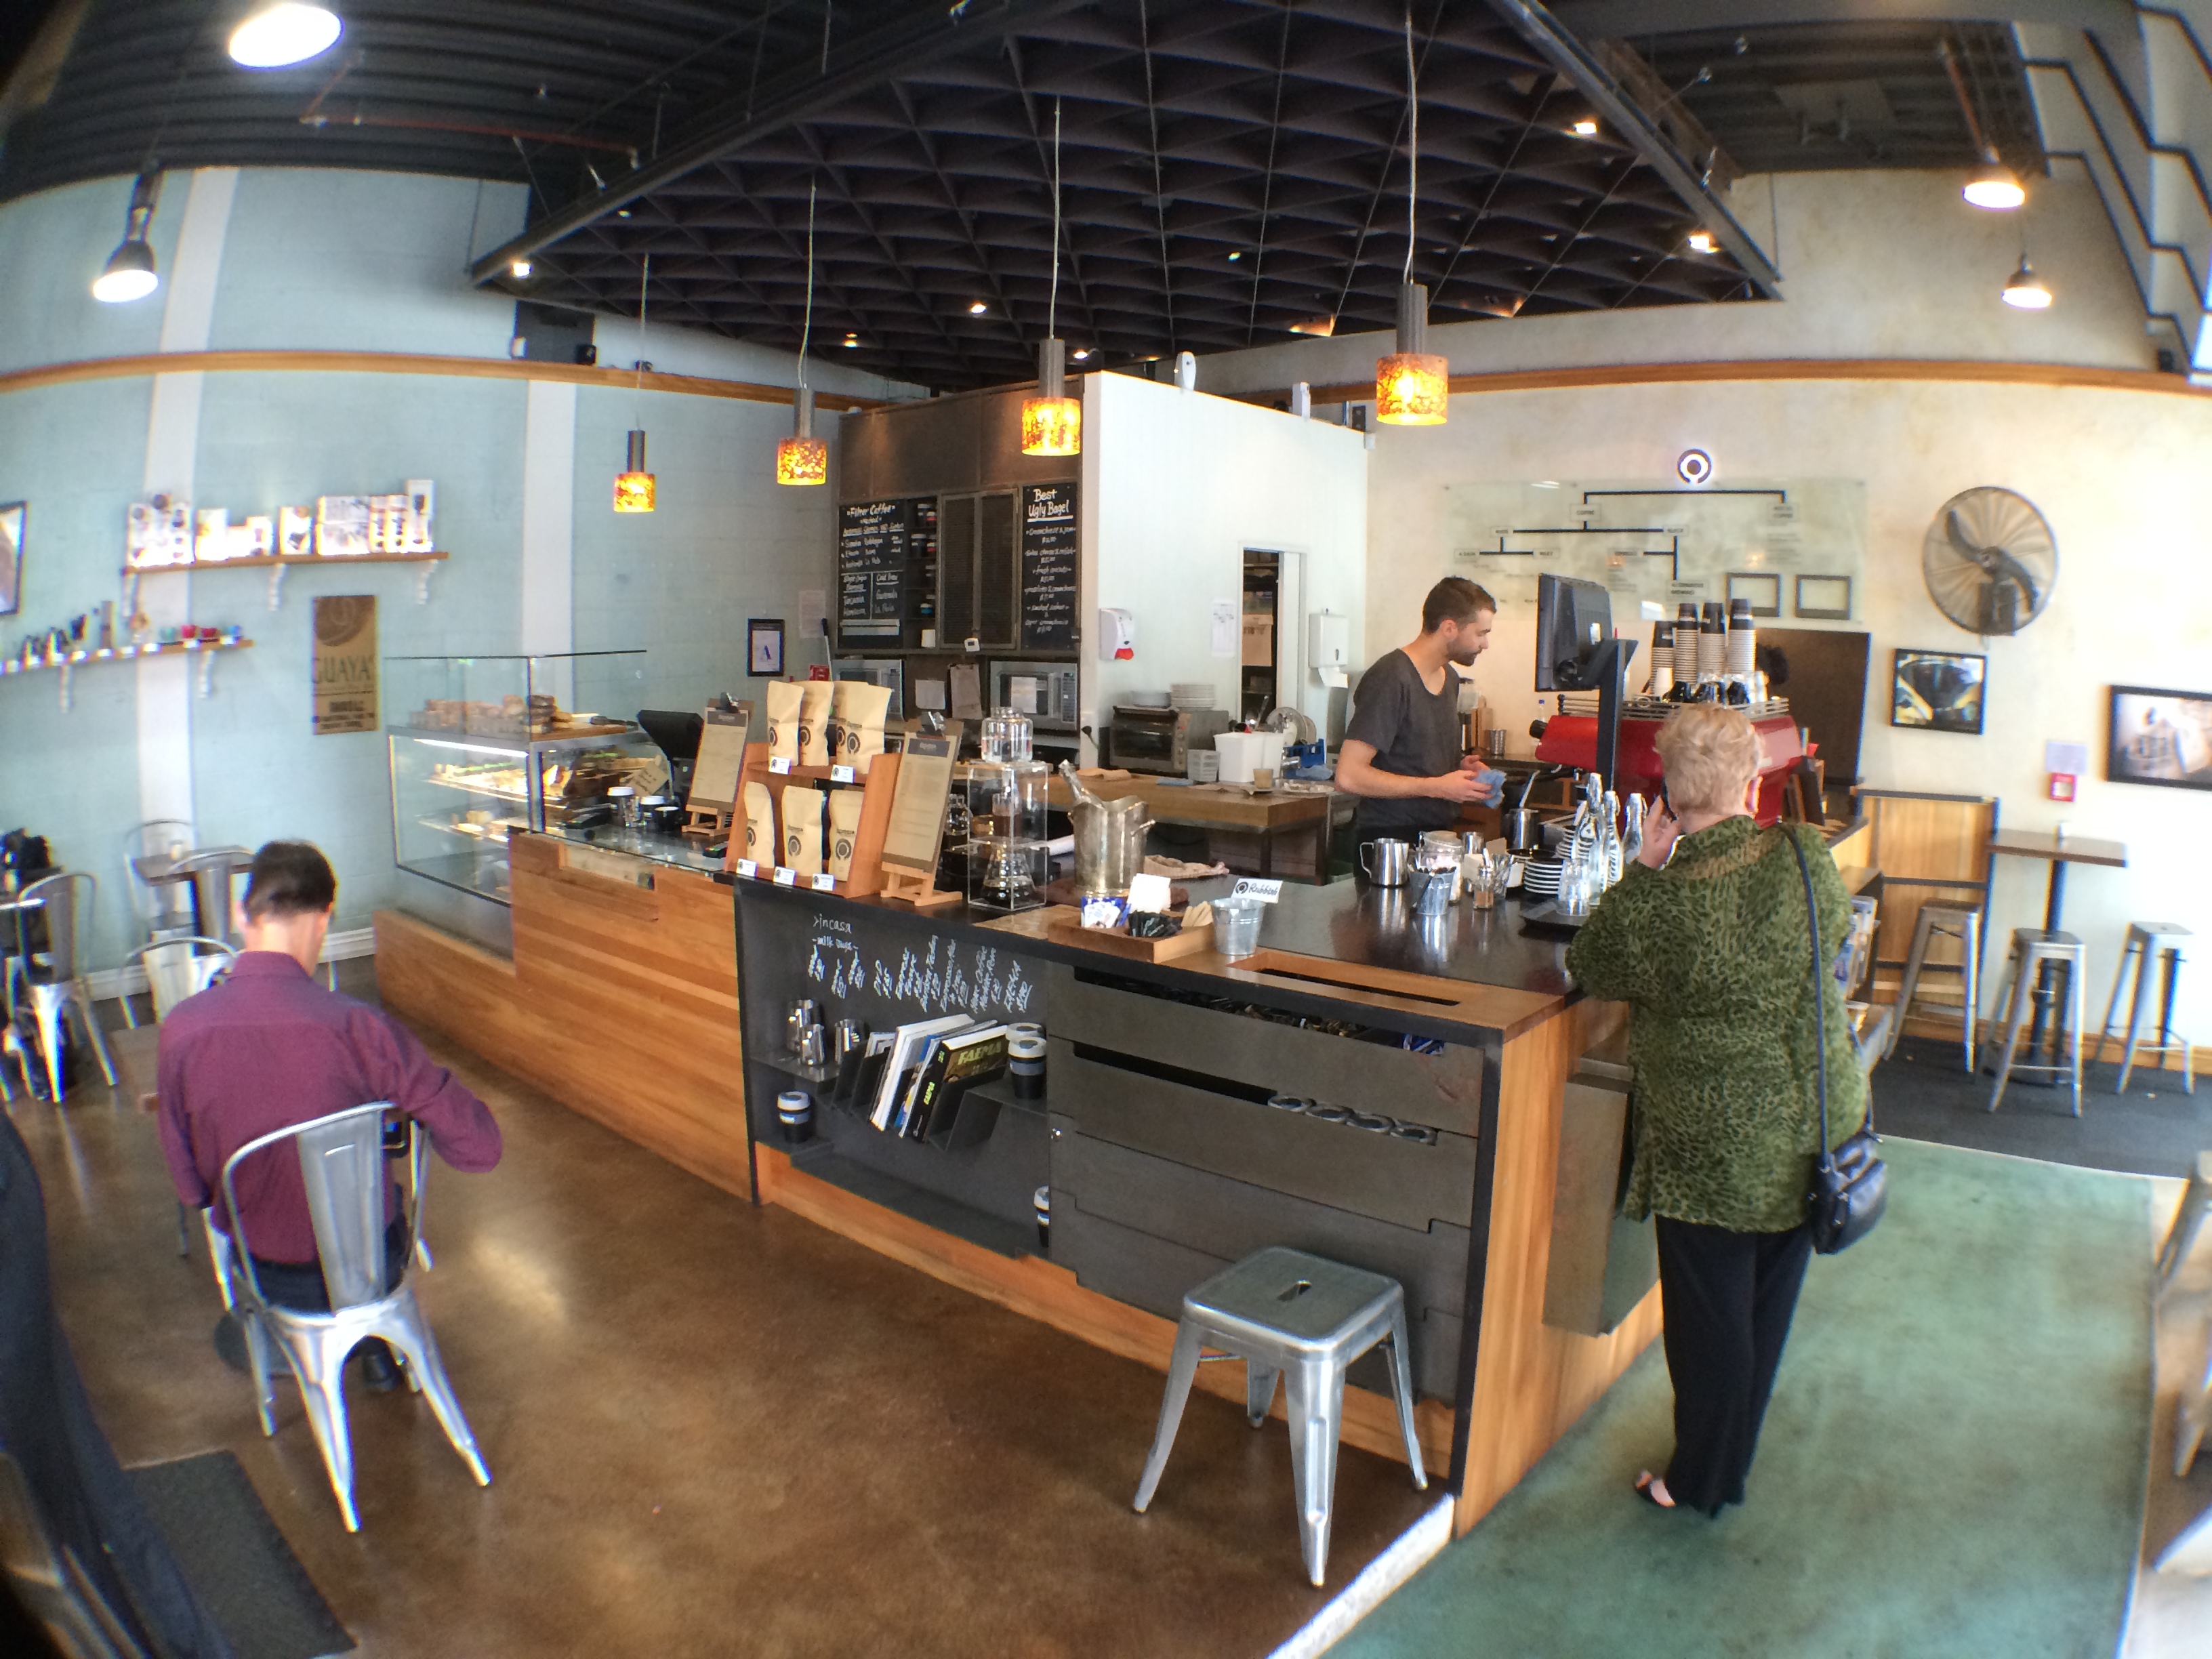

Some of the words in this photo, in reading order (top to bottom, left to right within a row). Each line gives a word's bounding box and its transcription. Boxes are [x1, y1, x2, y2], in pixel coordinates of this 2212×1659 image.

[1033, 488, 1057, 502] Best
[1028, 502, 1046, 518] Ugly
[1047, 499, 1069, 515] Bagel
[958, 1041, 1002, 1065] FAEMA
